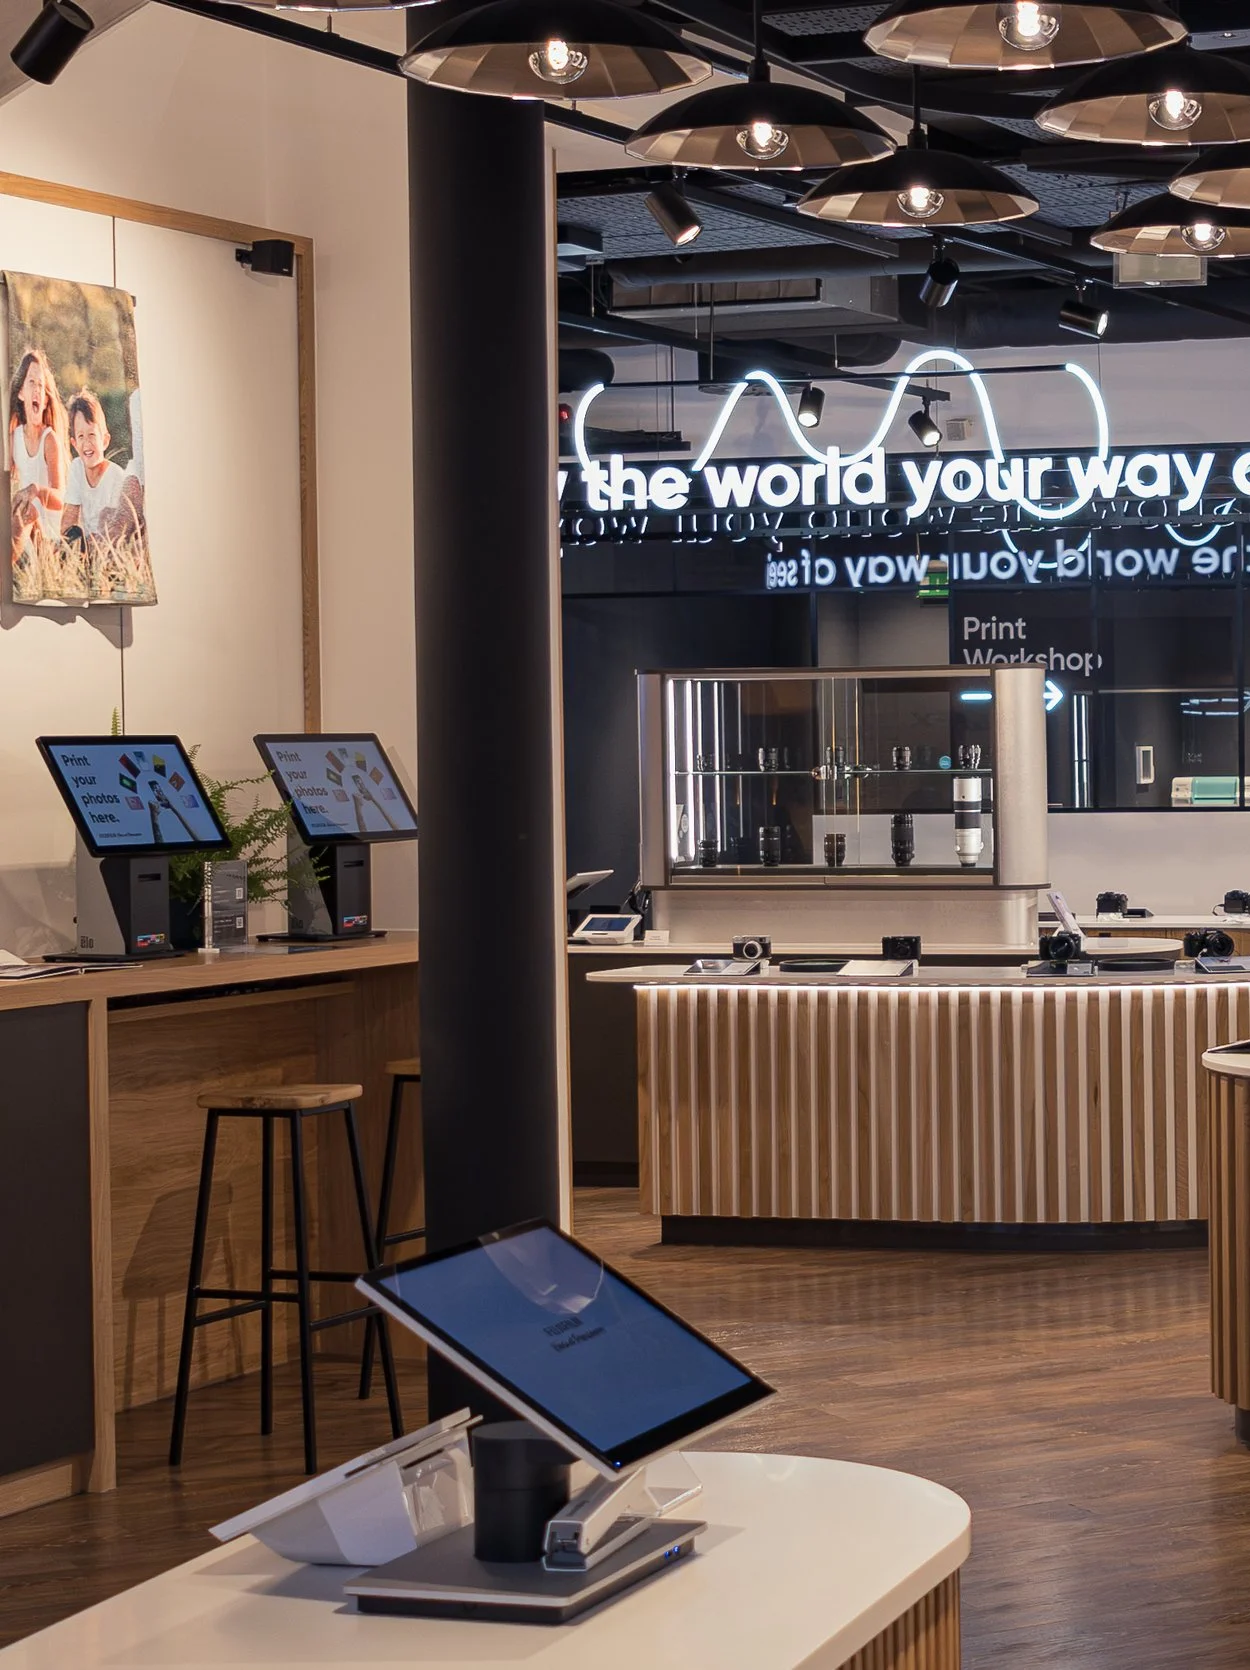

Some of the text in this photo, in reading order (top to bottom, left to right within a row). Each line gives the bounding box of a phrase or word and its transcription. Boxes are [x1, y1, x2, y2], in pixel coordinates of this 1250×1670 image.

[582, 454, 688, 511] the
[704, 446, 886, 508] world
[902, 457, 1051, 517] your
[1067, 452, 1215, 512] way
[963, 616, 1026, 640] Print
[61, 755, 91, 767] Print
[276, 751, 301, 762] Print
[72, 776, 97, 788] your
[286, 771, 307, 782] your
[295, 785, 328, 798] photos
[81, 792, 120, 807] photos
[301, 803, 329, 814] here.
[89, 812, 120, 823] here.
